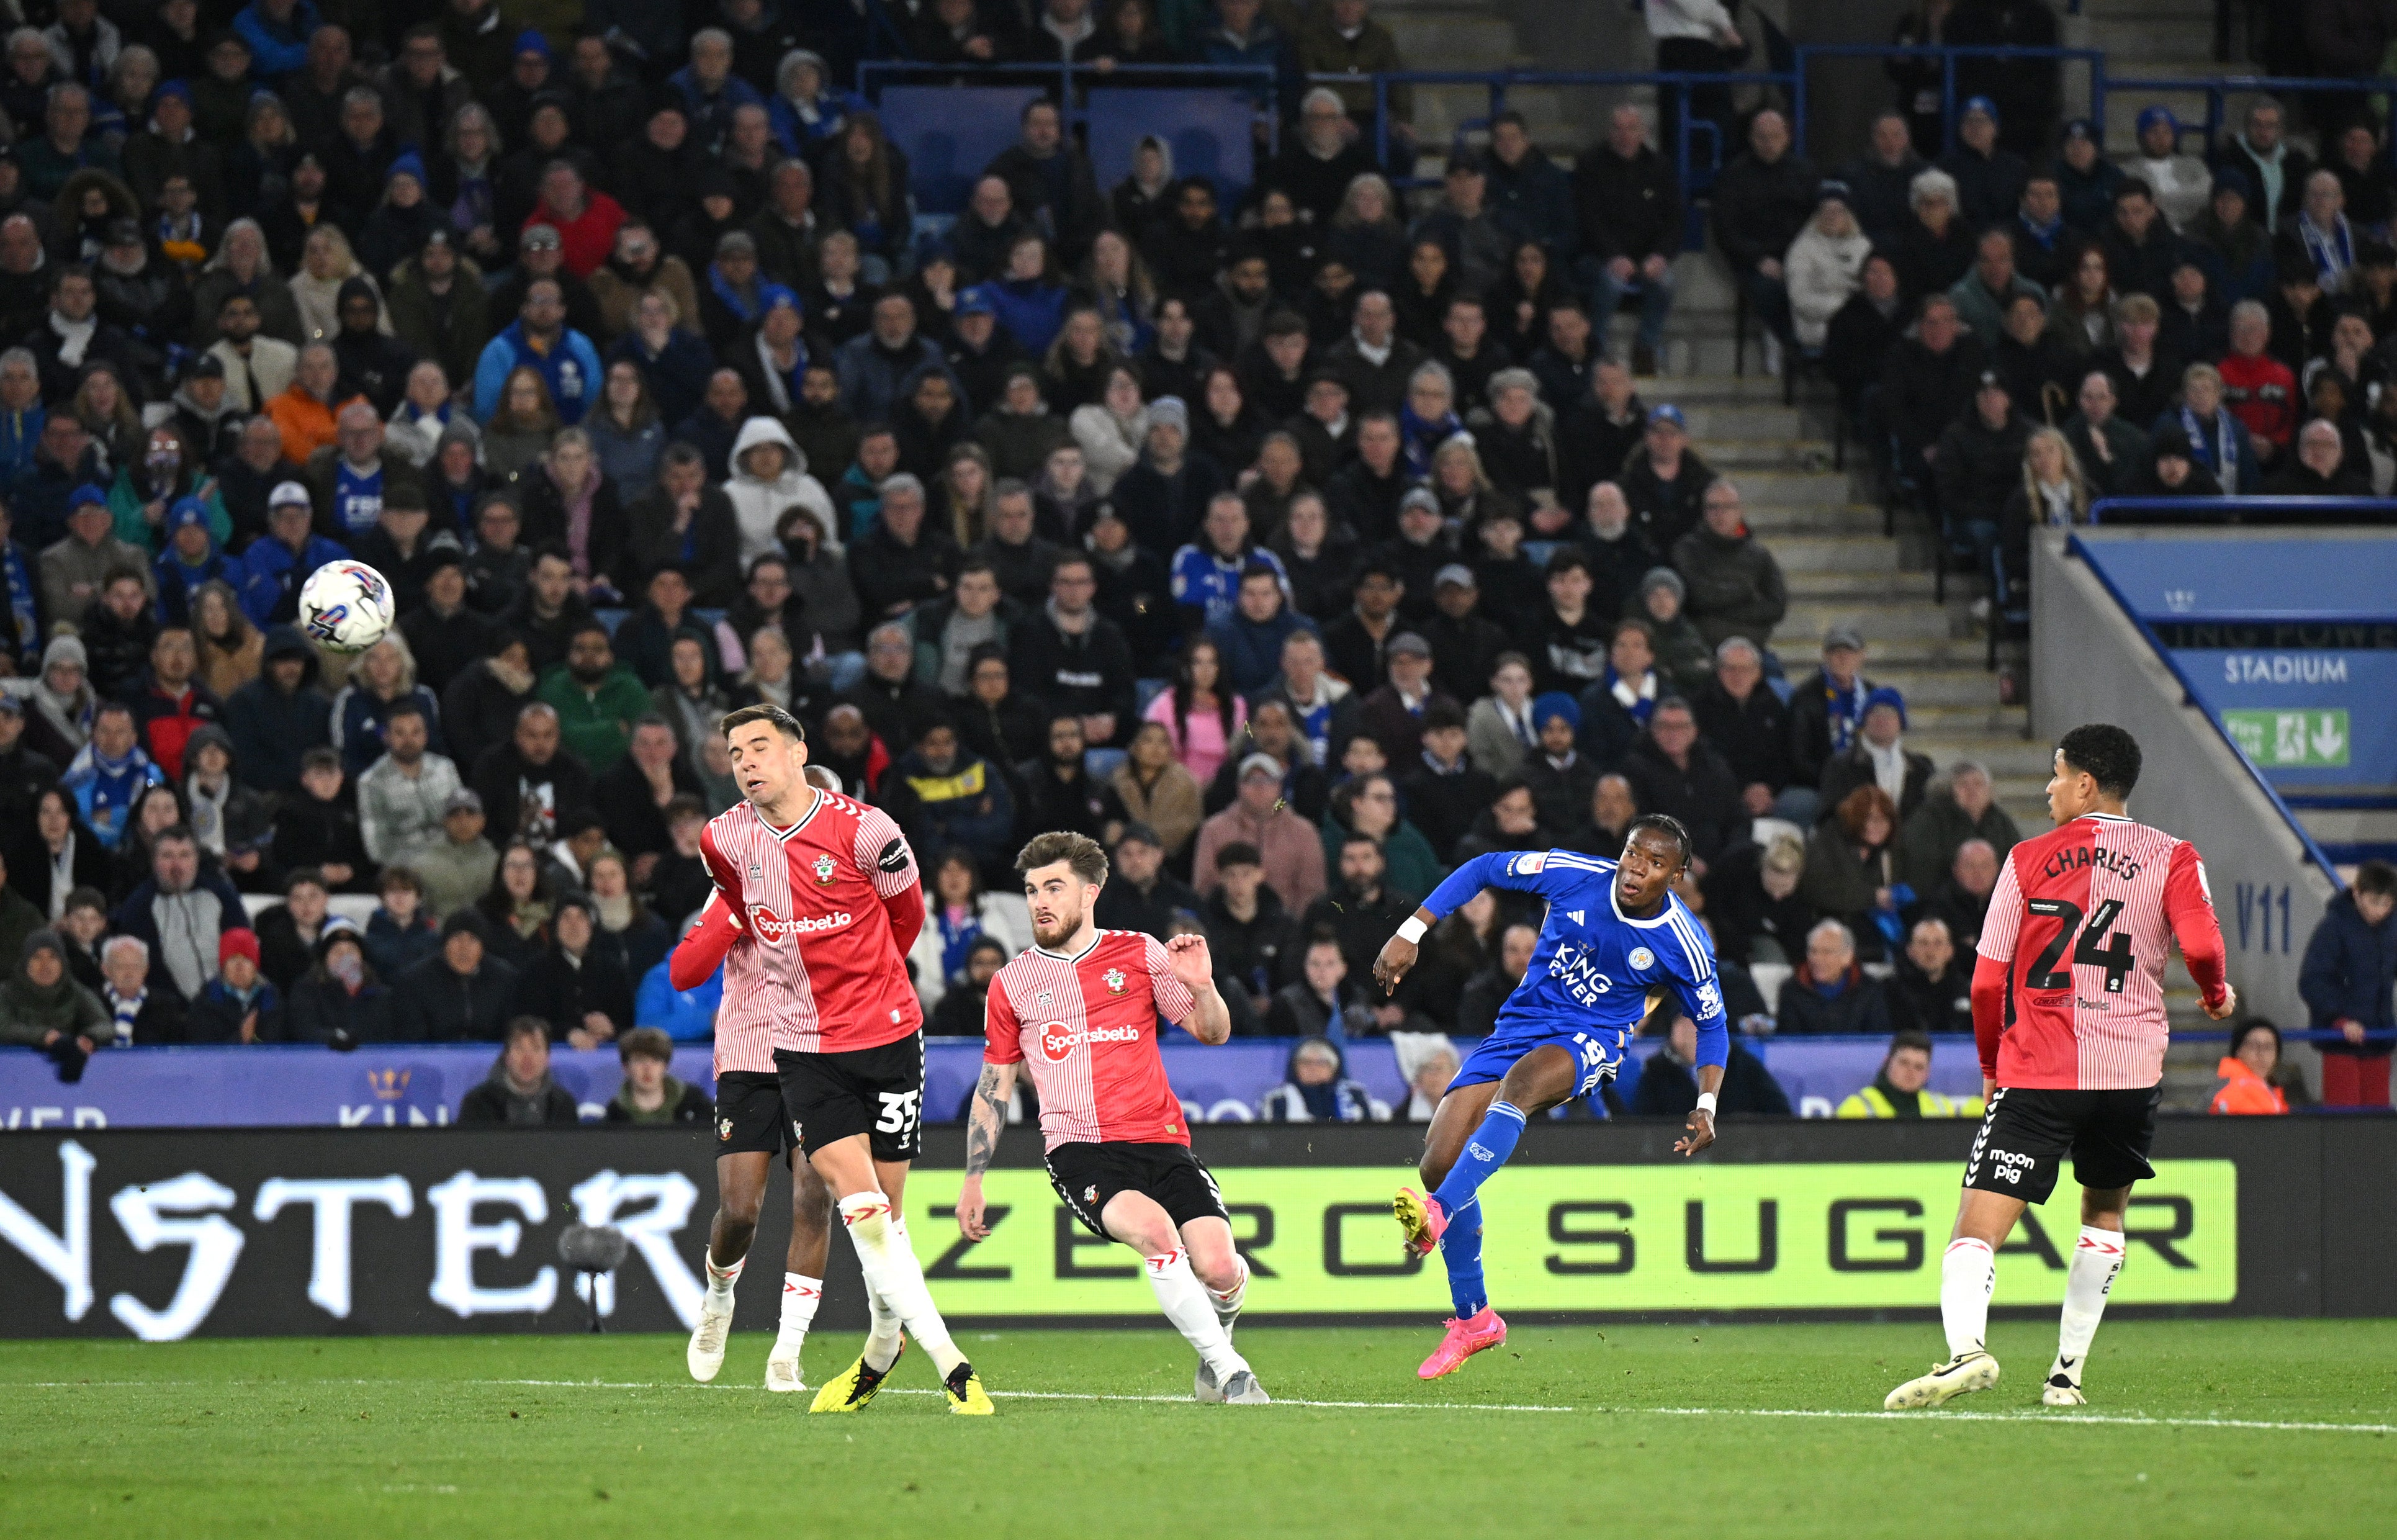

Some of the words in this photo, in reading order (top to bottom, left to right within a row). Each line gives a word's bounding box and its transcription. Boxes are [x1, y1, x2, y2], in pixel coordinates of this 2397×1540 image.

[2225, 654, 2347, 683] STADIUM
[2044, 847, 2141, 881] CHARLES
[758, 911, 852, 935] Sportsbet.io
[2236, 882, 2290, 954] V11
[2025, 898, 2135, 993] 24
[1549, 958, 1598, 1007] POWER
[1555, 942, 1612, 993] KING
[2077, 997, 2110, 1011] Tools
[1045, 1024, 1139, 1053] Sportsbet.io
[1573, 1032, 1606, 1066] 18
[875, 1089, 919, 1133] 35
[1989, 1149, 2035, 1170] moon
[1994, 1164, 2021, 1184] pig
[925, 1202, 1424, 1281] ZERO
[2101, 1263, 2120, 1295] SFC
